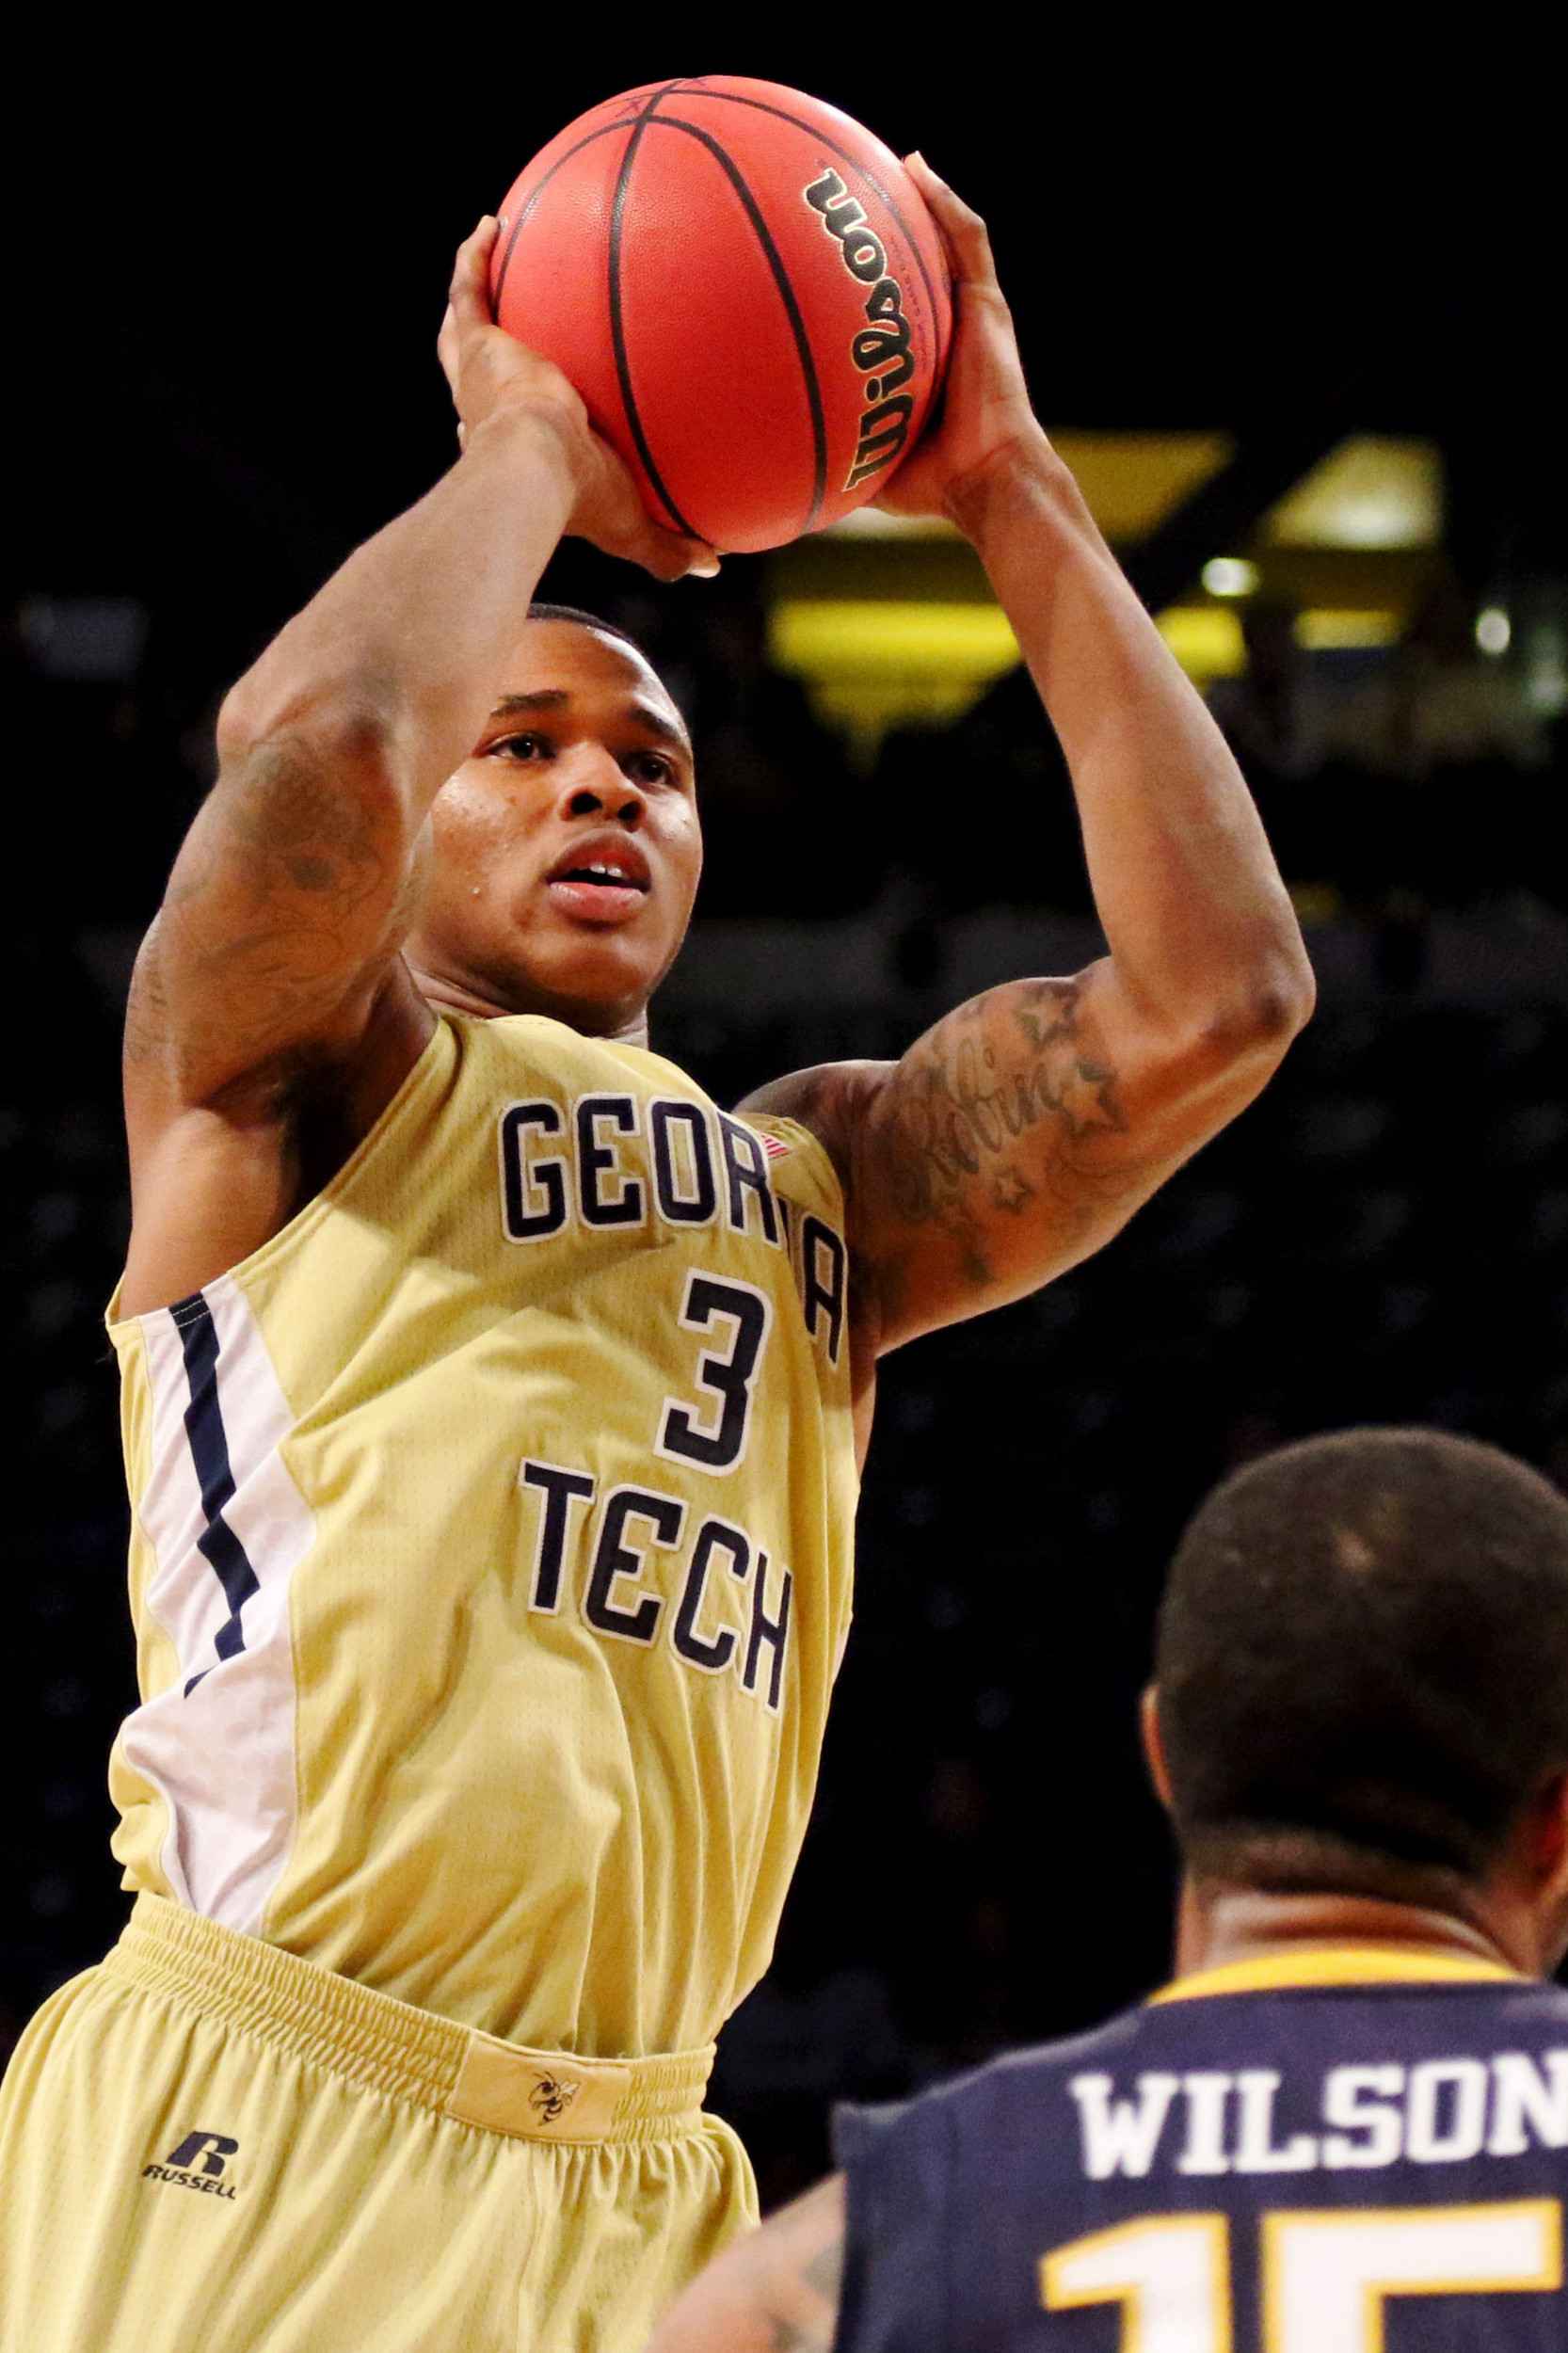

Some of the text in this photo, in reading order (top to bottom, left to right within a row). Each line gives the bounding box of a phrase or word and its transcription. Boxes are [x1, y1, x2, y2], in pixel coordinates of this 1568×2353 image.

[803, 168, 914, 492] Wilson
[499, 1092, 848, 1370] GEORA
[654, 1267, 775, 1477] 3
[519, 1457, 793, 1712] TECH
[142, 2165, 235, 2200] RUSSELL
[1069, 2049, 1568, 2181] WILSON
